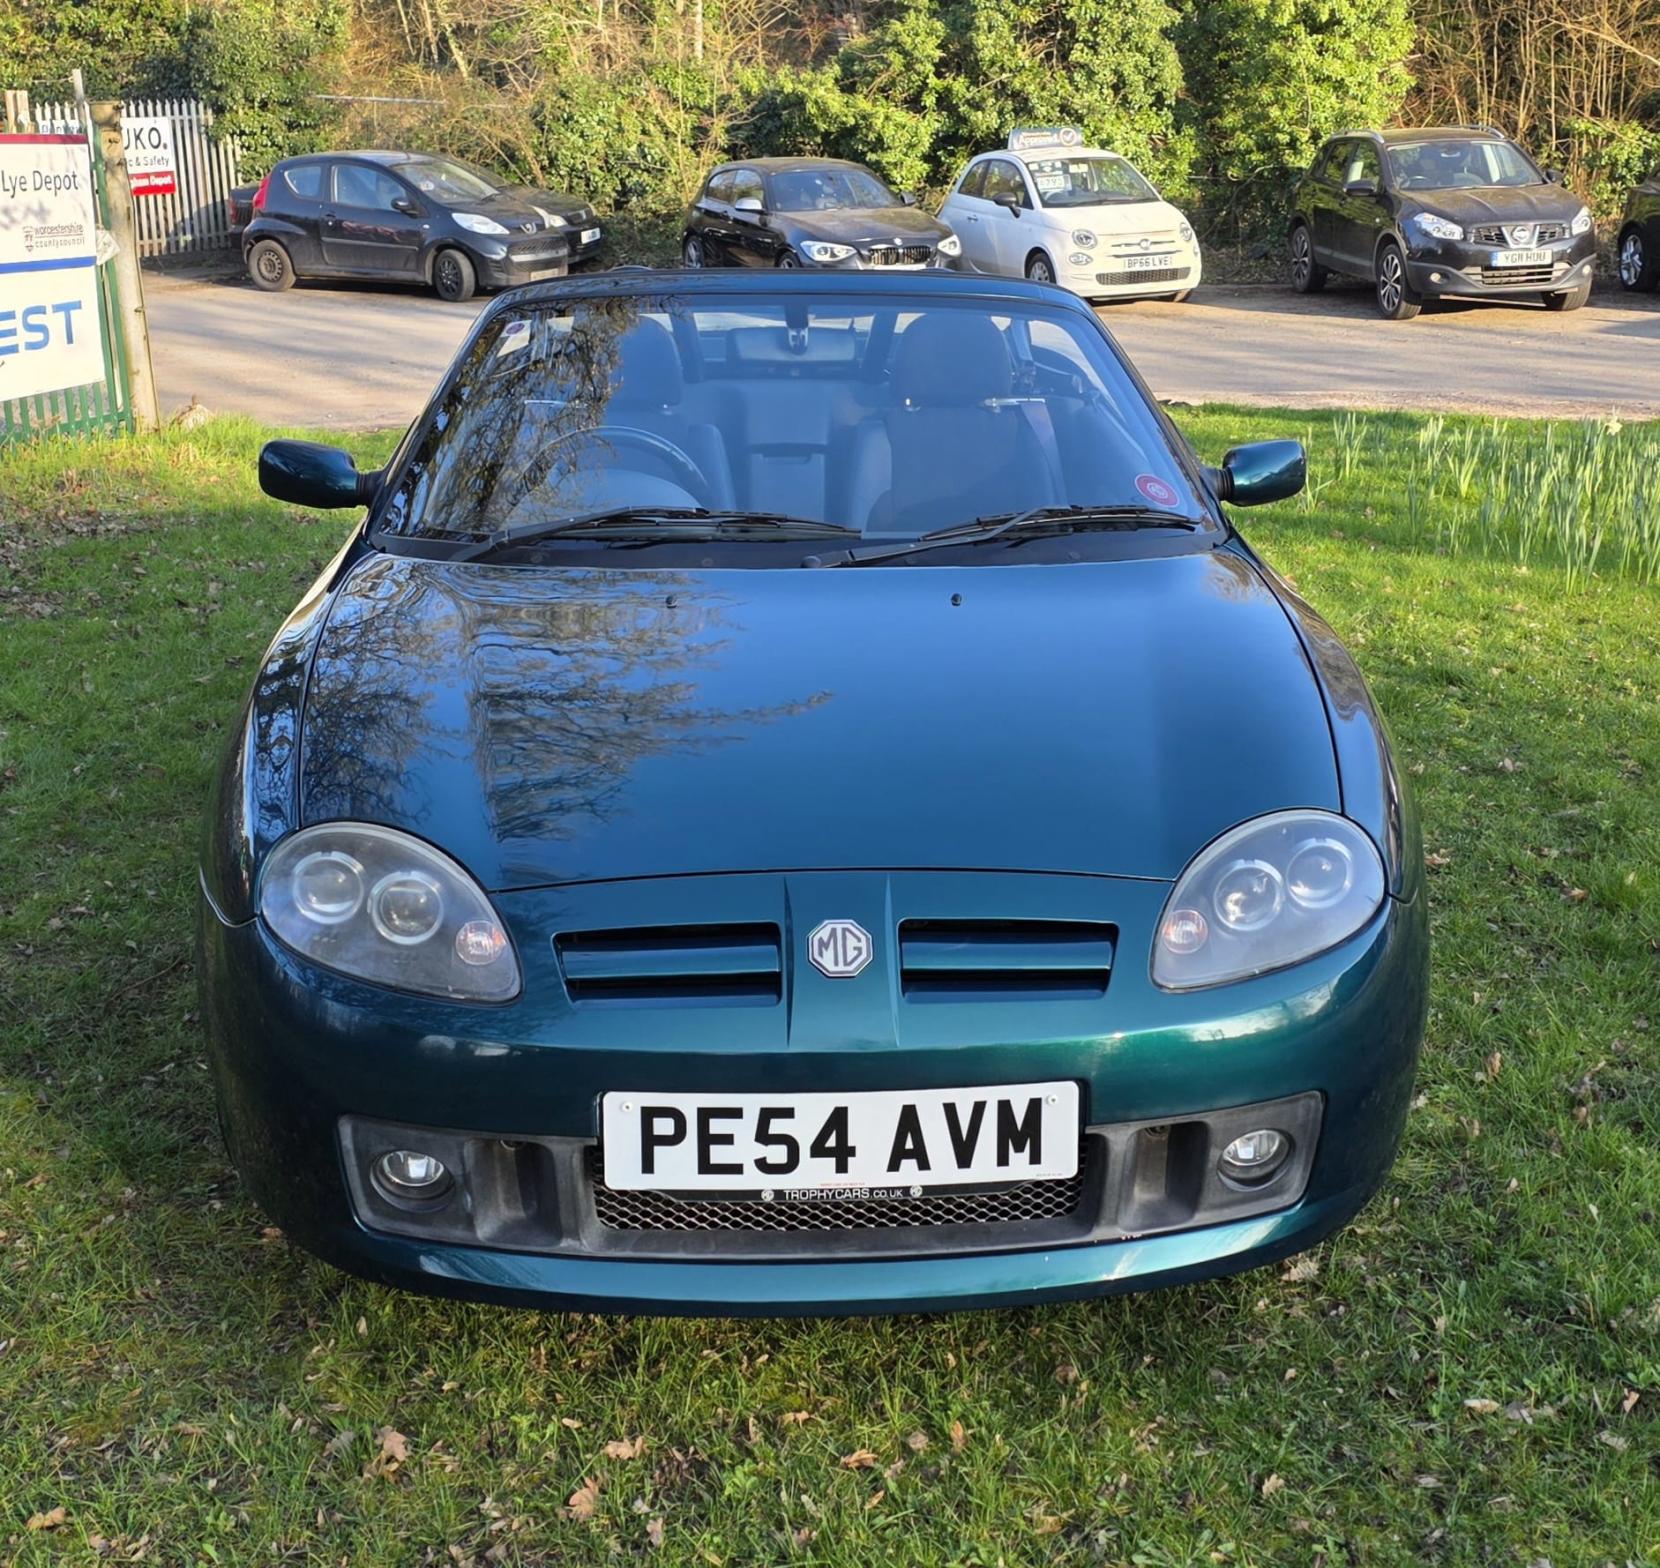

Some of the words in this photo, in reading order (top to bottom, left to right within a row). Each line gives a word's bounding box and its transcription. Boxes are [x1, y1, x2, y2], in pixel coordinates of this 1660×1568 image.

[143, 155, 169, 167] Safety
[2, 170, 27, 199] Lye
[33, 169, 79, 197] Depot
[0, 300, 82, 356] EST
[817, 927, 863, 967] MG
[640, 1105, 857, 1175] PE54
[886, 1097, 1043, 1173] AVM
